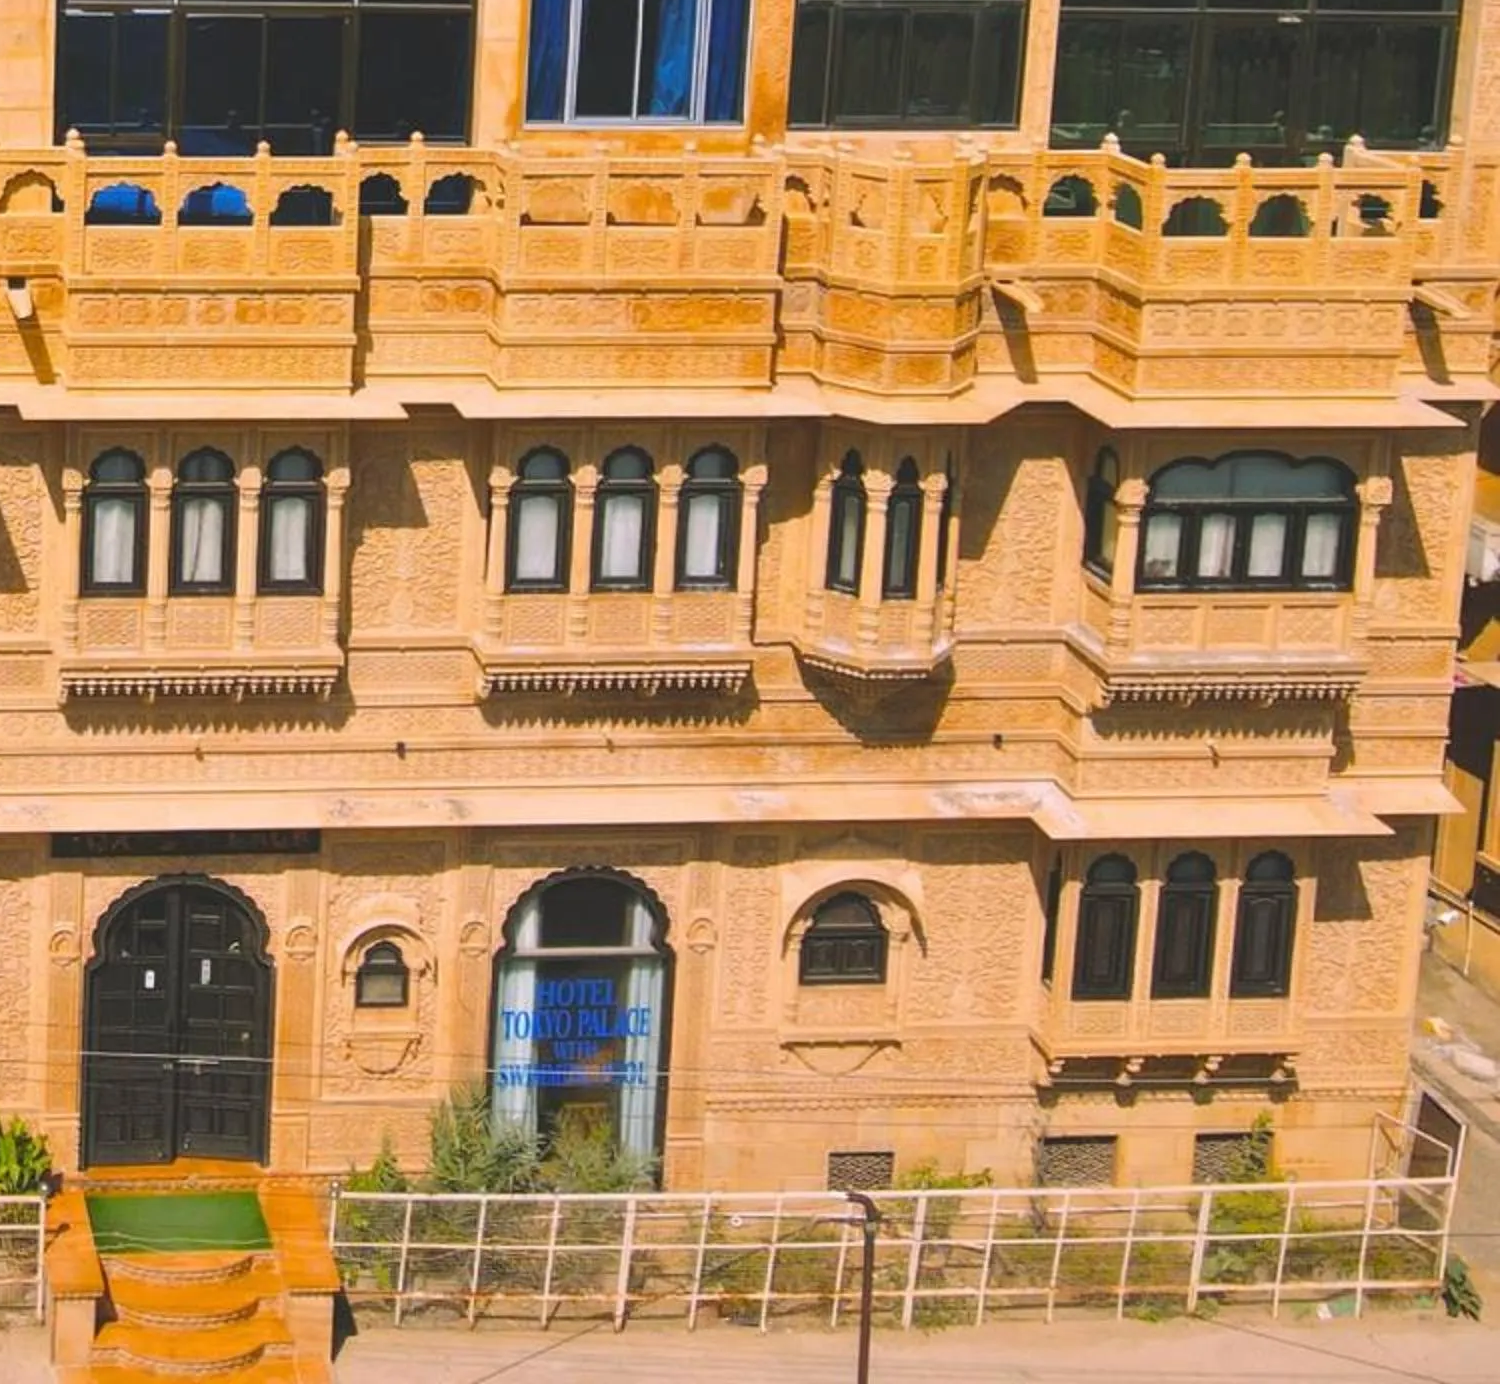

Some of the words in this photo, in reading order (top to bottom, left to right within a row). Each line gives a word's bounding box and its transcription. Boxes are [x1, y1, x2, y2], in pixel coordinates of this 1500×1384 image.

[536, 978, 615, 1008] HOTEL
[501, 1009, 573, 1041] TOKYO
[577, 1005, 651, 1037] PALACE
